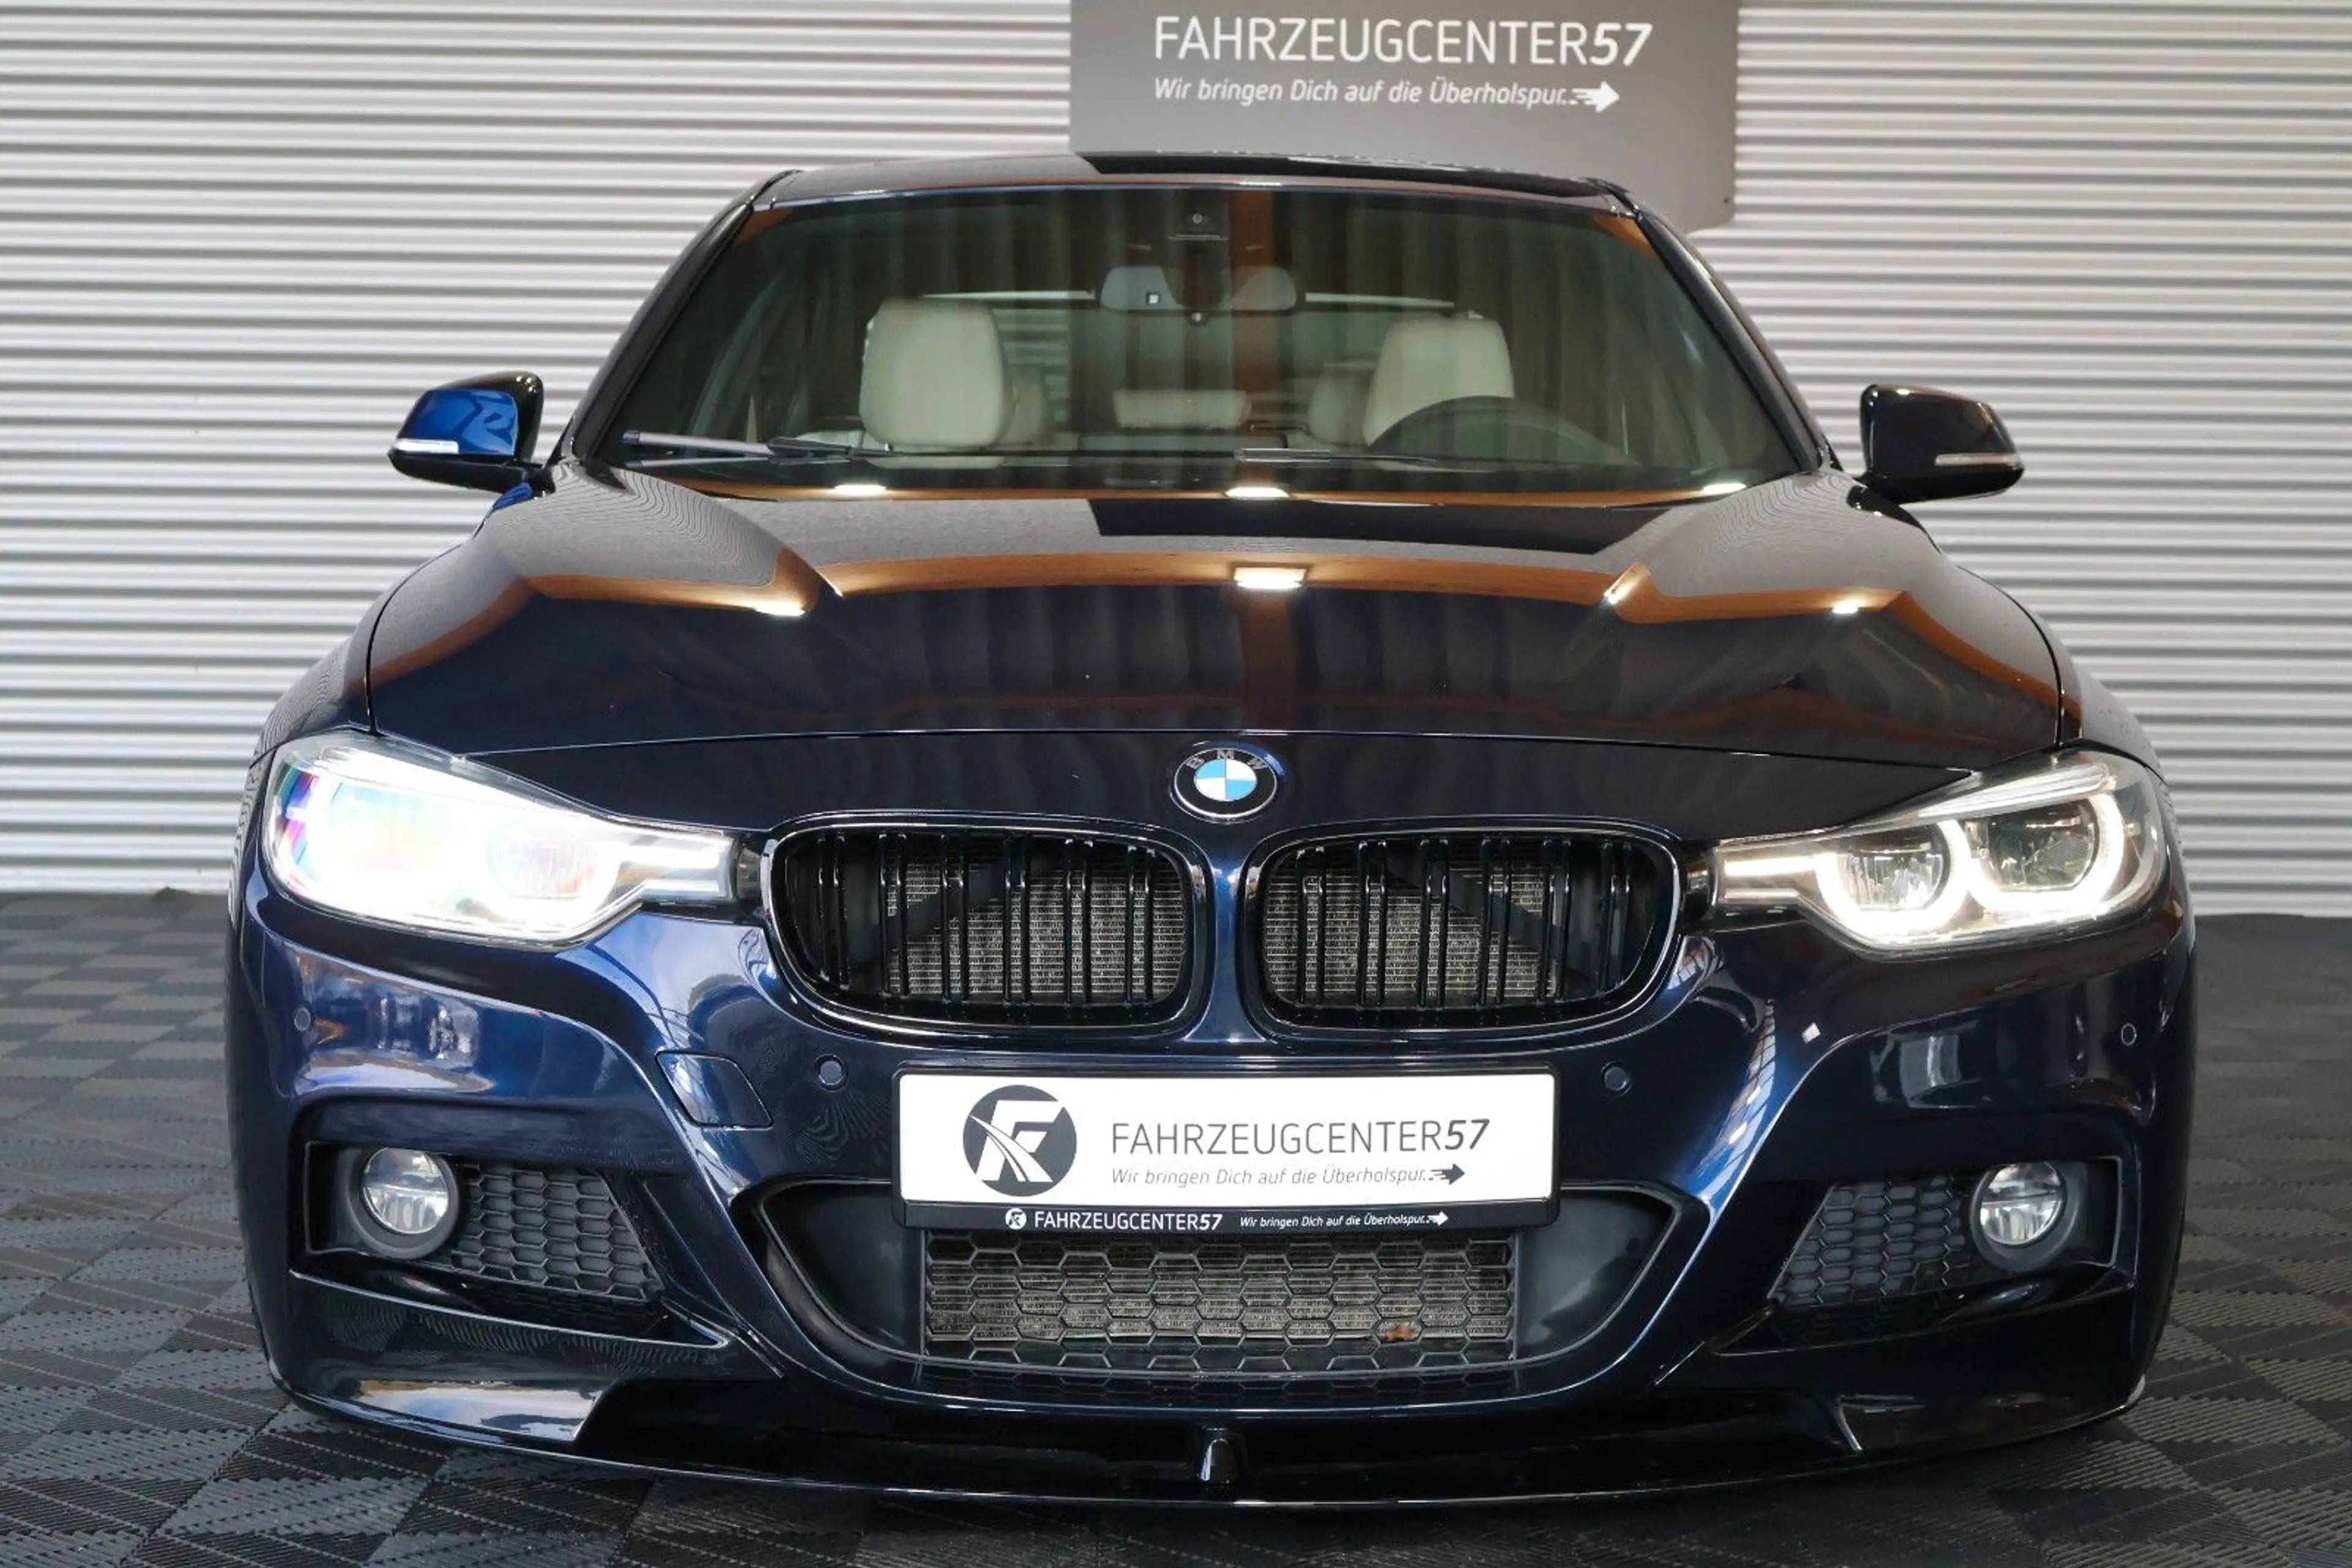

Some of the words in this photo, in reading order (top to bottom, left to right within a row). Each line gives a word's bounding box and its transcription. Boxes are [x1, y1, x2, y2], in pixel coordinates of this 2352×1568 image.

[1154, 15, 1654, 66] FAHRZEUGCENTER57
[1154, 76, 1192, 100] Wir
[1198, 78, 1283, 107] bringen
[1290, 78, 1338, 101] Dich
[1343, 79, 1385, 103] auf
[1388, 80, 1422, 103] die
[1112, 1118, 1490, 1155] FAHRZEUGCENTER57
[1111, 1167, 1140, 1185] Wir
[1144, 1168, 1210, 1189] bringen
[1215, 1167, 1252, 1185] Dich
[1257, 1168, 1287, 1185] auf
[1291, 1169, 1317, 1185] die
[1034, 1210, 1223, 1231] FAHRZEUGCENTER57
[1240, 1216, 1257, 1227] Wir
[1260, 1216, 1298, 1229] bringen
[1301, 1216, 1324, 1227] Dich
[1326, 1215, 1344, 1226] auf
[1345, 1215, 1361, 1226] die
